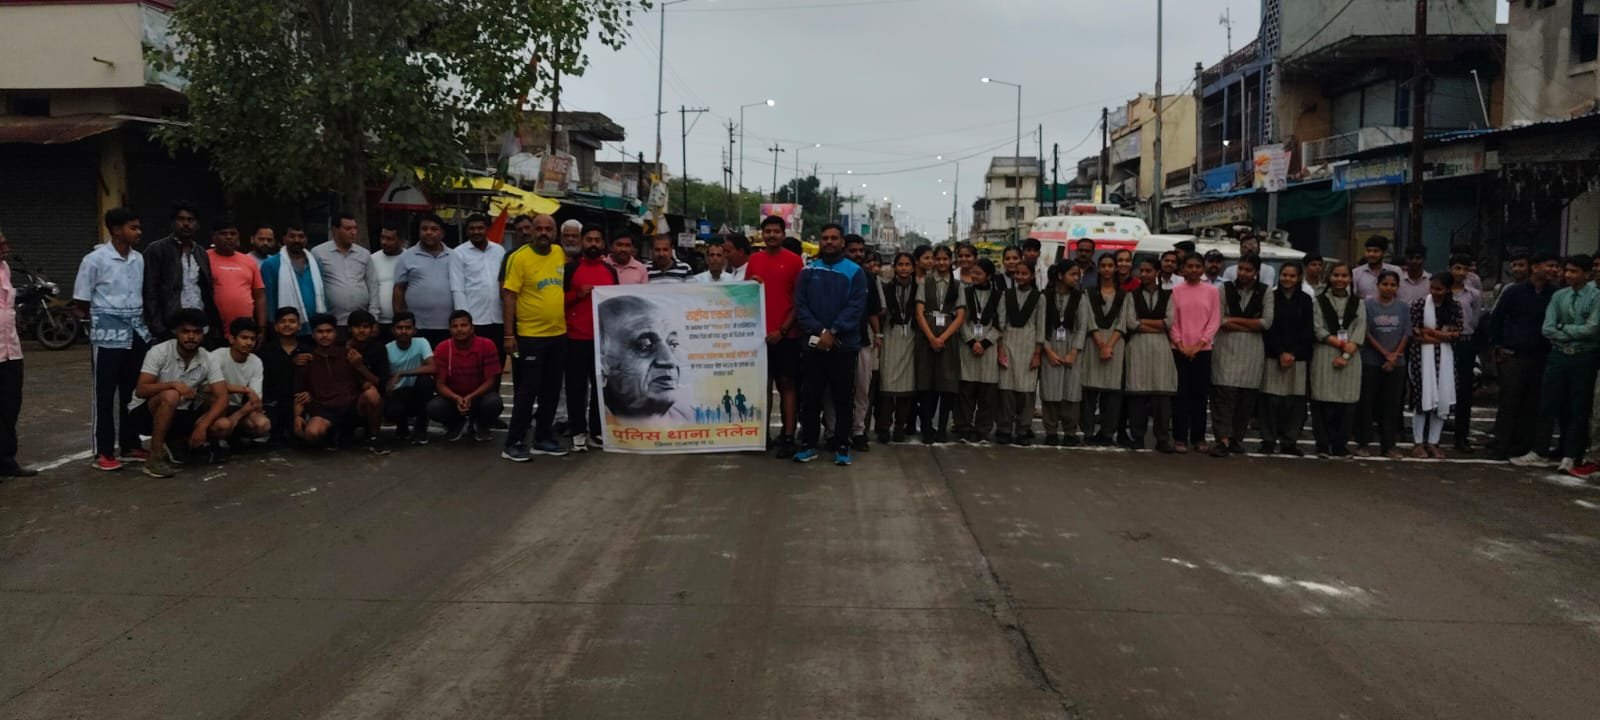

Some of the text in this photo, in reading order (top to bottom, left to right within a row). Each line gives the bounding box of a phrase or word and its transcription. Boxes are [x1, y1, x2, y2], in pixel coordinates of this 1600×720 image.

[612, 423, 760, 443] पुलिस थाना तलेन
